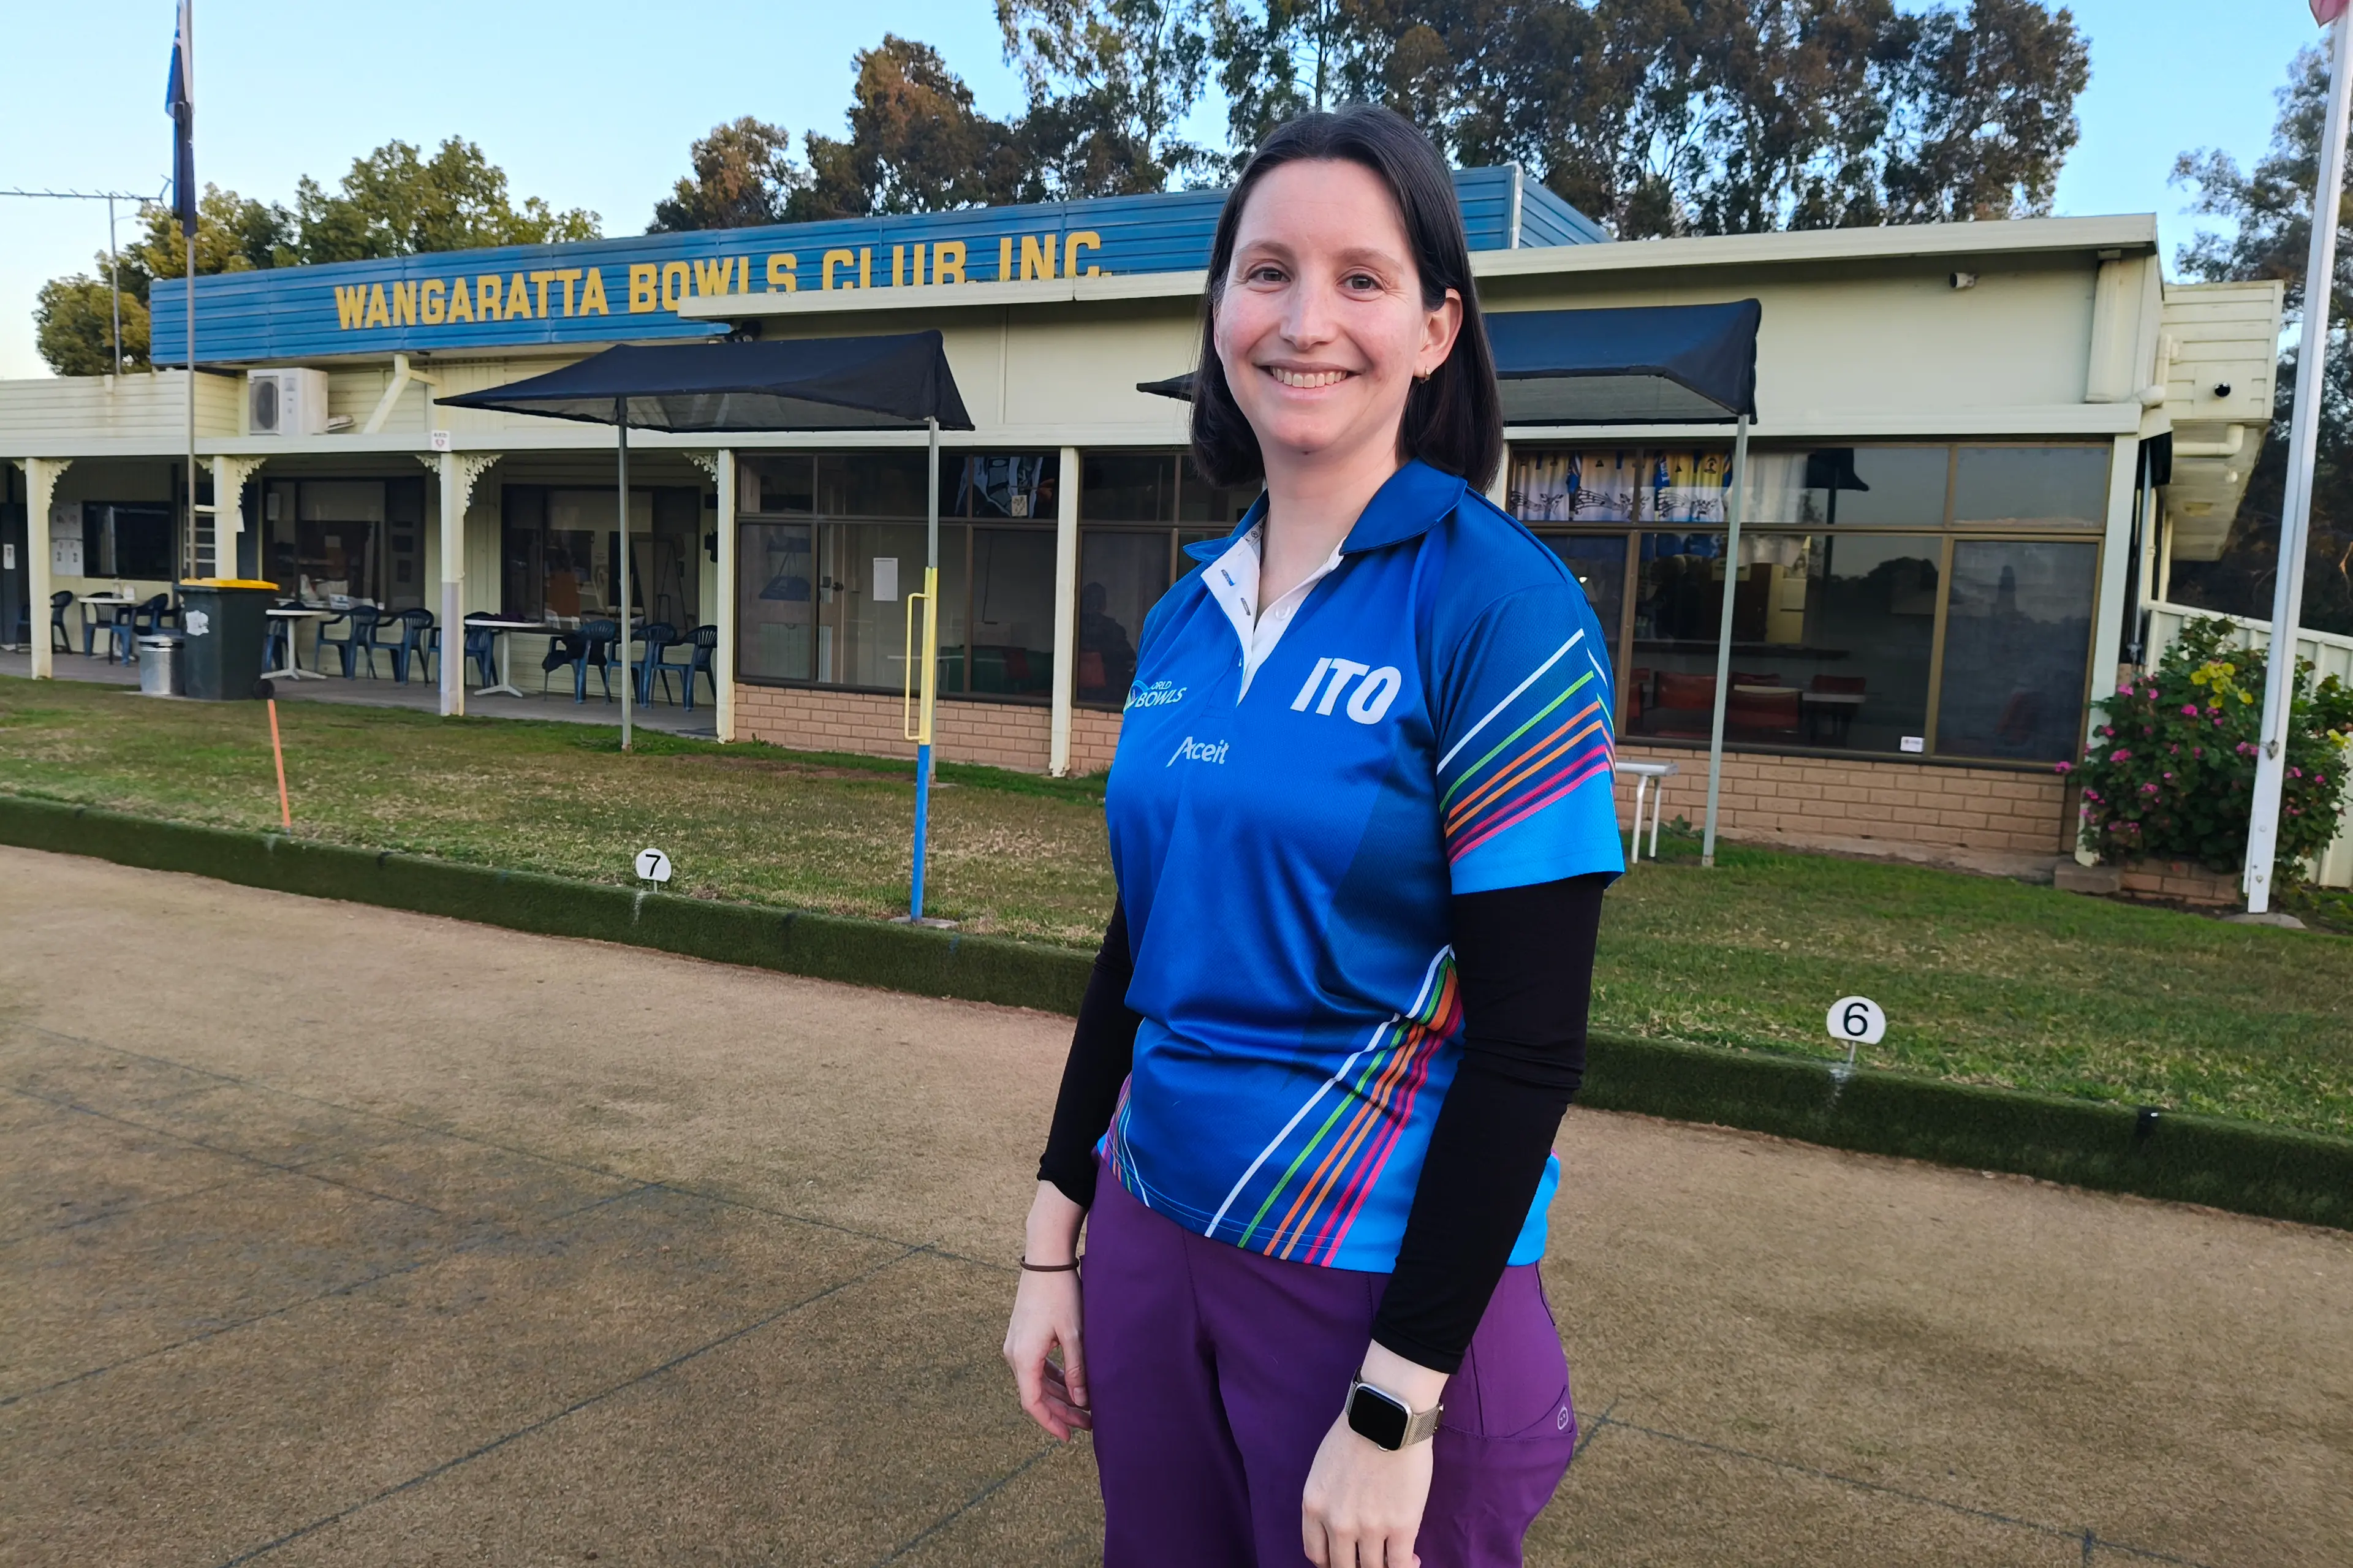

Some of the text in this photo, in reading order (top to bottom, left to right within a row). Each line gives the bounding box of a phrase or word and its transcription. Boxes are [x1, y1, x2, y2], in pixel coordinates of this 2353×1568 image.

[335, 267, 610, 330] WANGARATTA
[1134, 687, 1188, 708] BOWLS
[1289, 657, 1402, 725] ITO
[1165, 736, 1230, 768] Aceit
[645, 853, 661, 877] 7
[1843, 1002, 1869, 1037] 6
